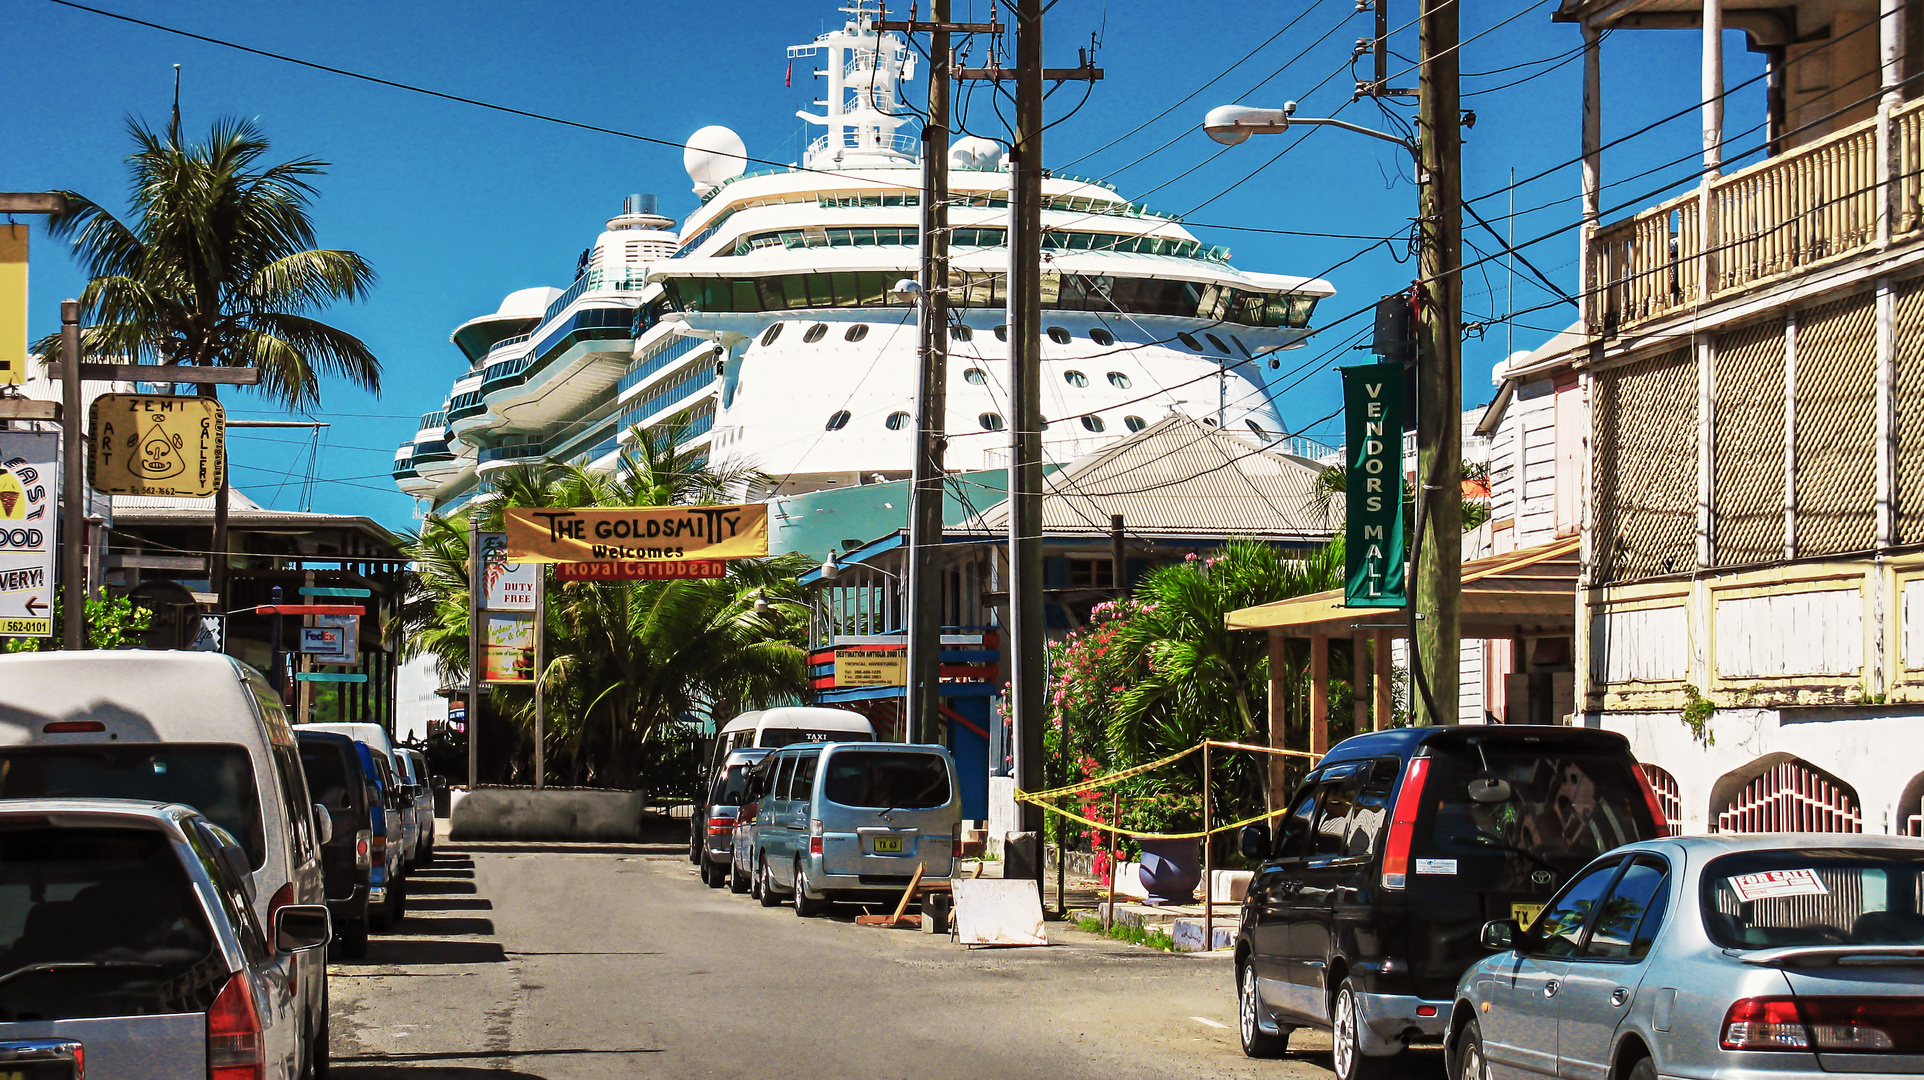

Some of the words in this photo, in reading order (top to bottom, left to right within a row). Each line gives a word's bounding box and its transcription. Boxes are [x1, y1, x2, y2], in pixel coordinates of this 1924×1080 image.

[129, 400, 184, 412] ZEMI
[102, 421, 114, 466] ART
[1365, 383, 1383, 512] VENDORS
[199, 417, 210, 488] GALLERY
[0, 454, 47, 521] EAST
[533, 511, 586, 543] THE
[595, 508, 741, 544] GOLDSMITTY
[591, 545, 685, 559] Welcomes
[1364, 525, 1383, 596] MALL
[566, 562, 618, 575] Royal
[626, 561, 722, 575] Caribbean
[504, 582, 533, 592] DUTY
[503, 594, 531, 603] FREE
[7, 621, 47, 632] 562-0101
[305, 630, 337, 641] FedEx
[889, 841, 897, 849] 63
[1737, 871, 1770, 885] FOR
[1770, 869, 1811, 882] SALE
[1514, 911, 1529, 925] TX
